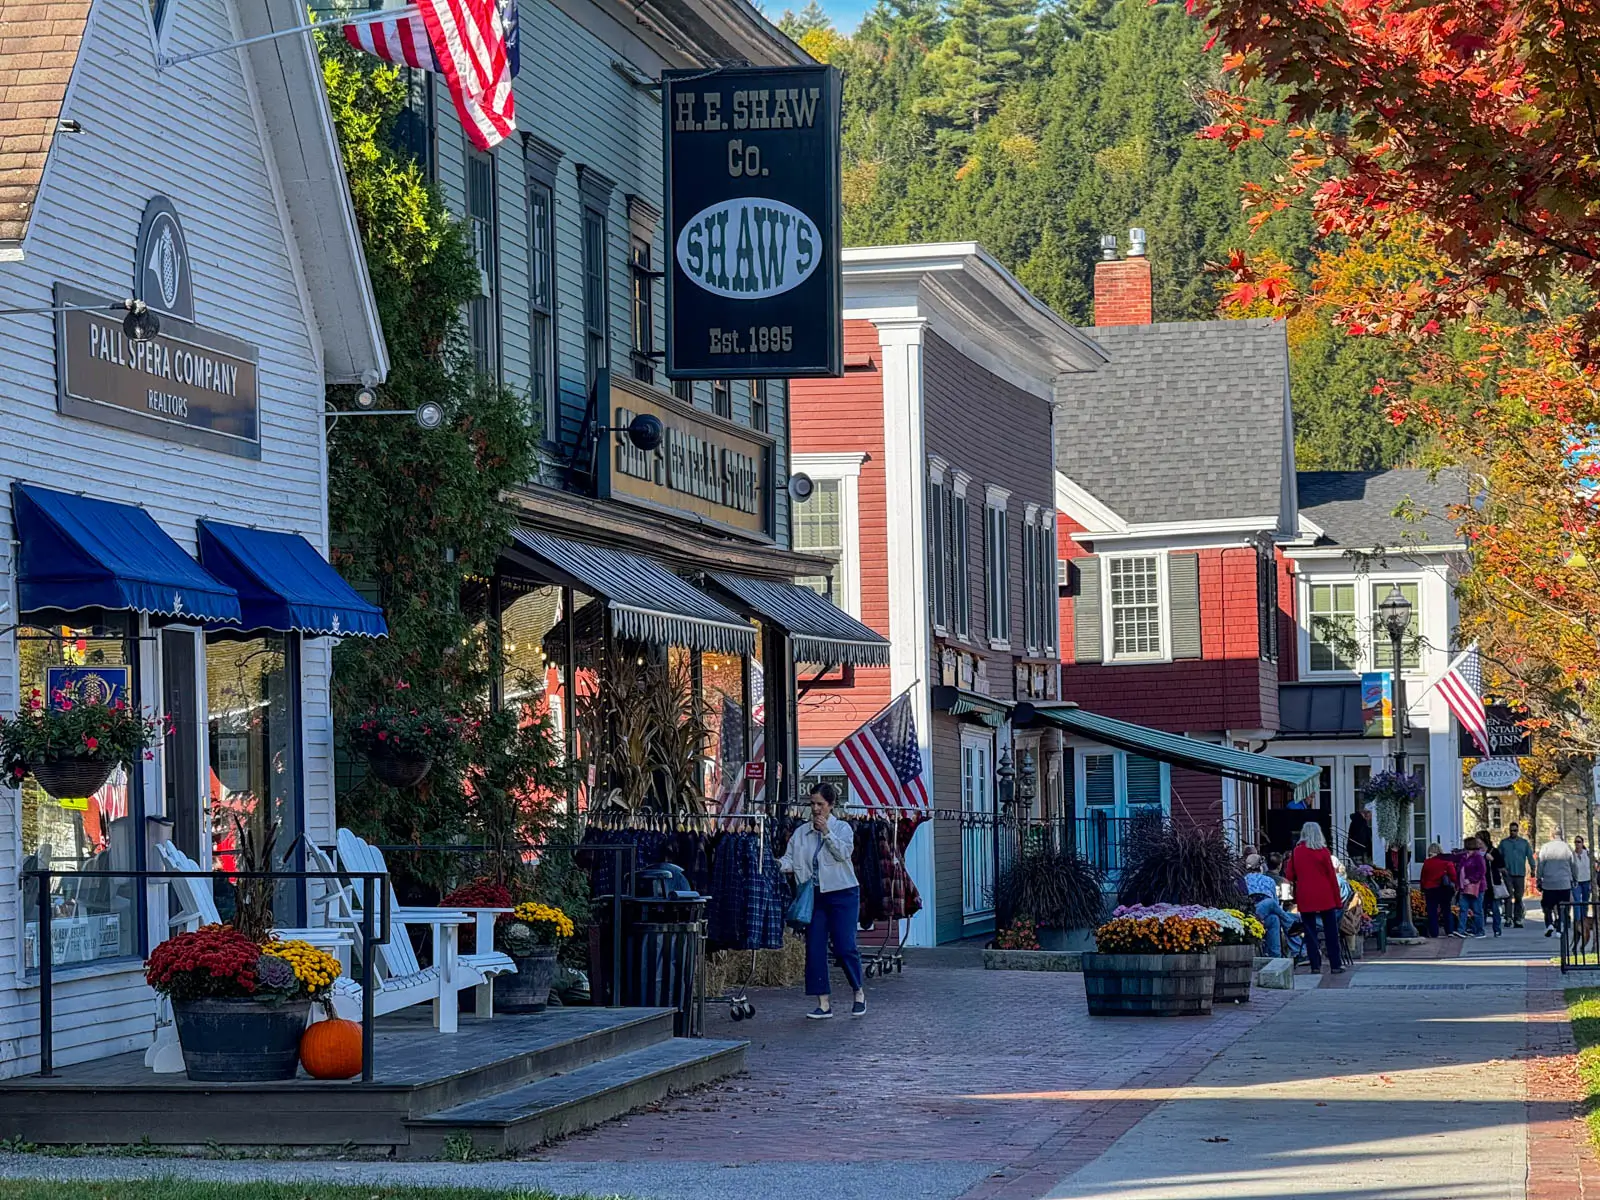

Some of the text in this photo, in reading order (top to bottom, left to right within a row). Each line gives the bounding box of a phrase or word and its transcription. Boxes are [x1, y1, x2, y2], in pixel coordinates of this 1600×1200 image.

[675, 88, 820, 131] H.E. SHAW
[686, 205, 813, 292] SHAW'S
[709, 325, 793, 354] Est. 1895
[90, 323, 238, 397] PALL SPERA COMPANY
[148, 389, 188, 418] REALTORS
[616, 407, 759, 514] SHAS GENERAL STORE
[799, 782, 843, 796] BOS
[1472, 770, 1518, 778] BREAKFAST
